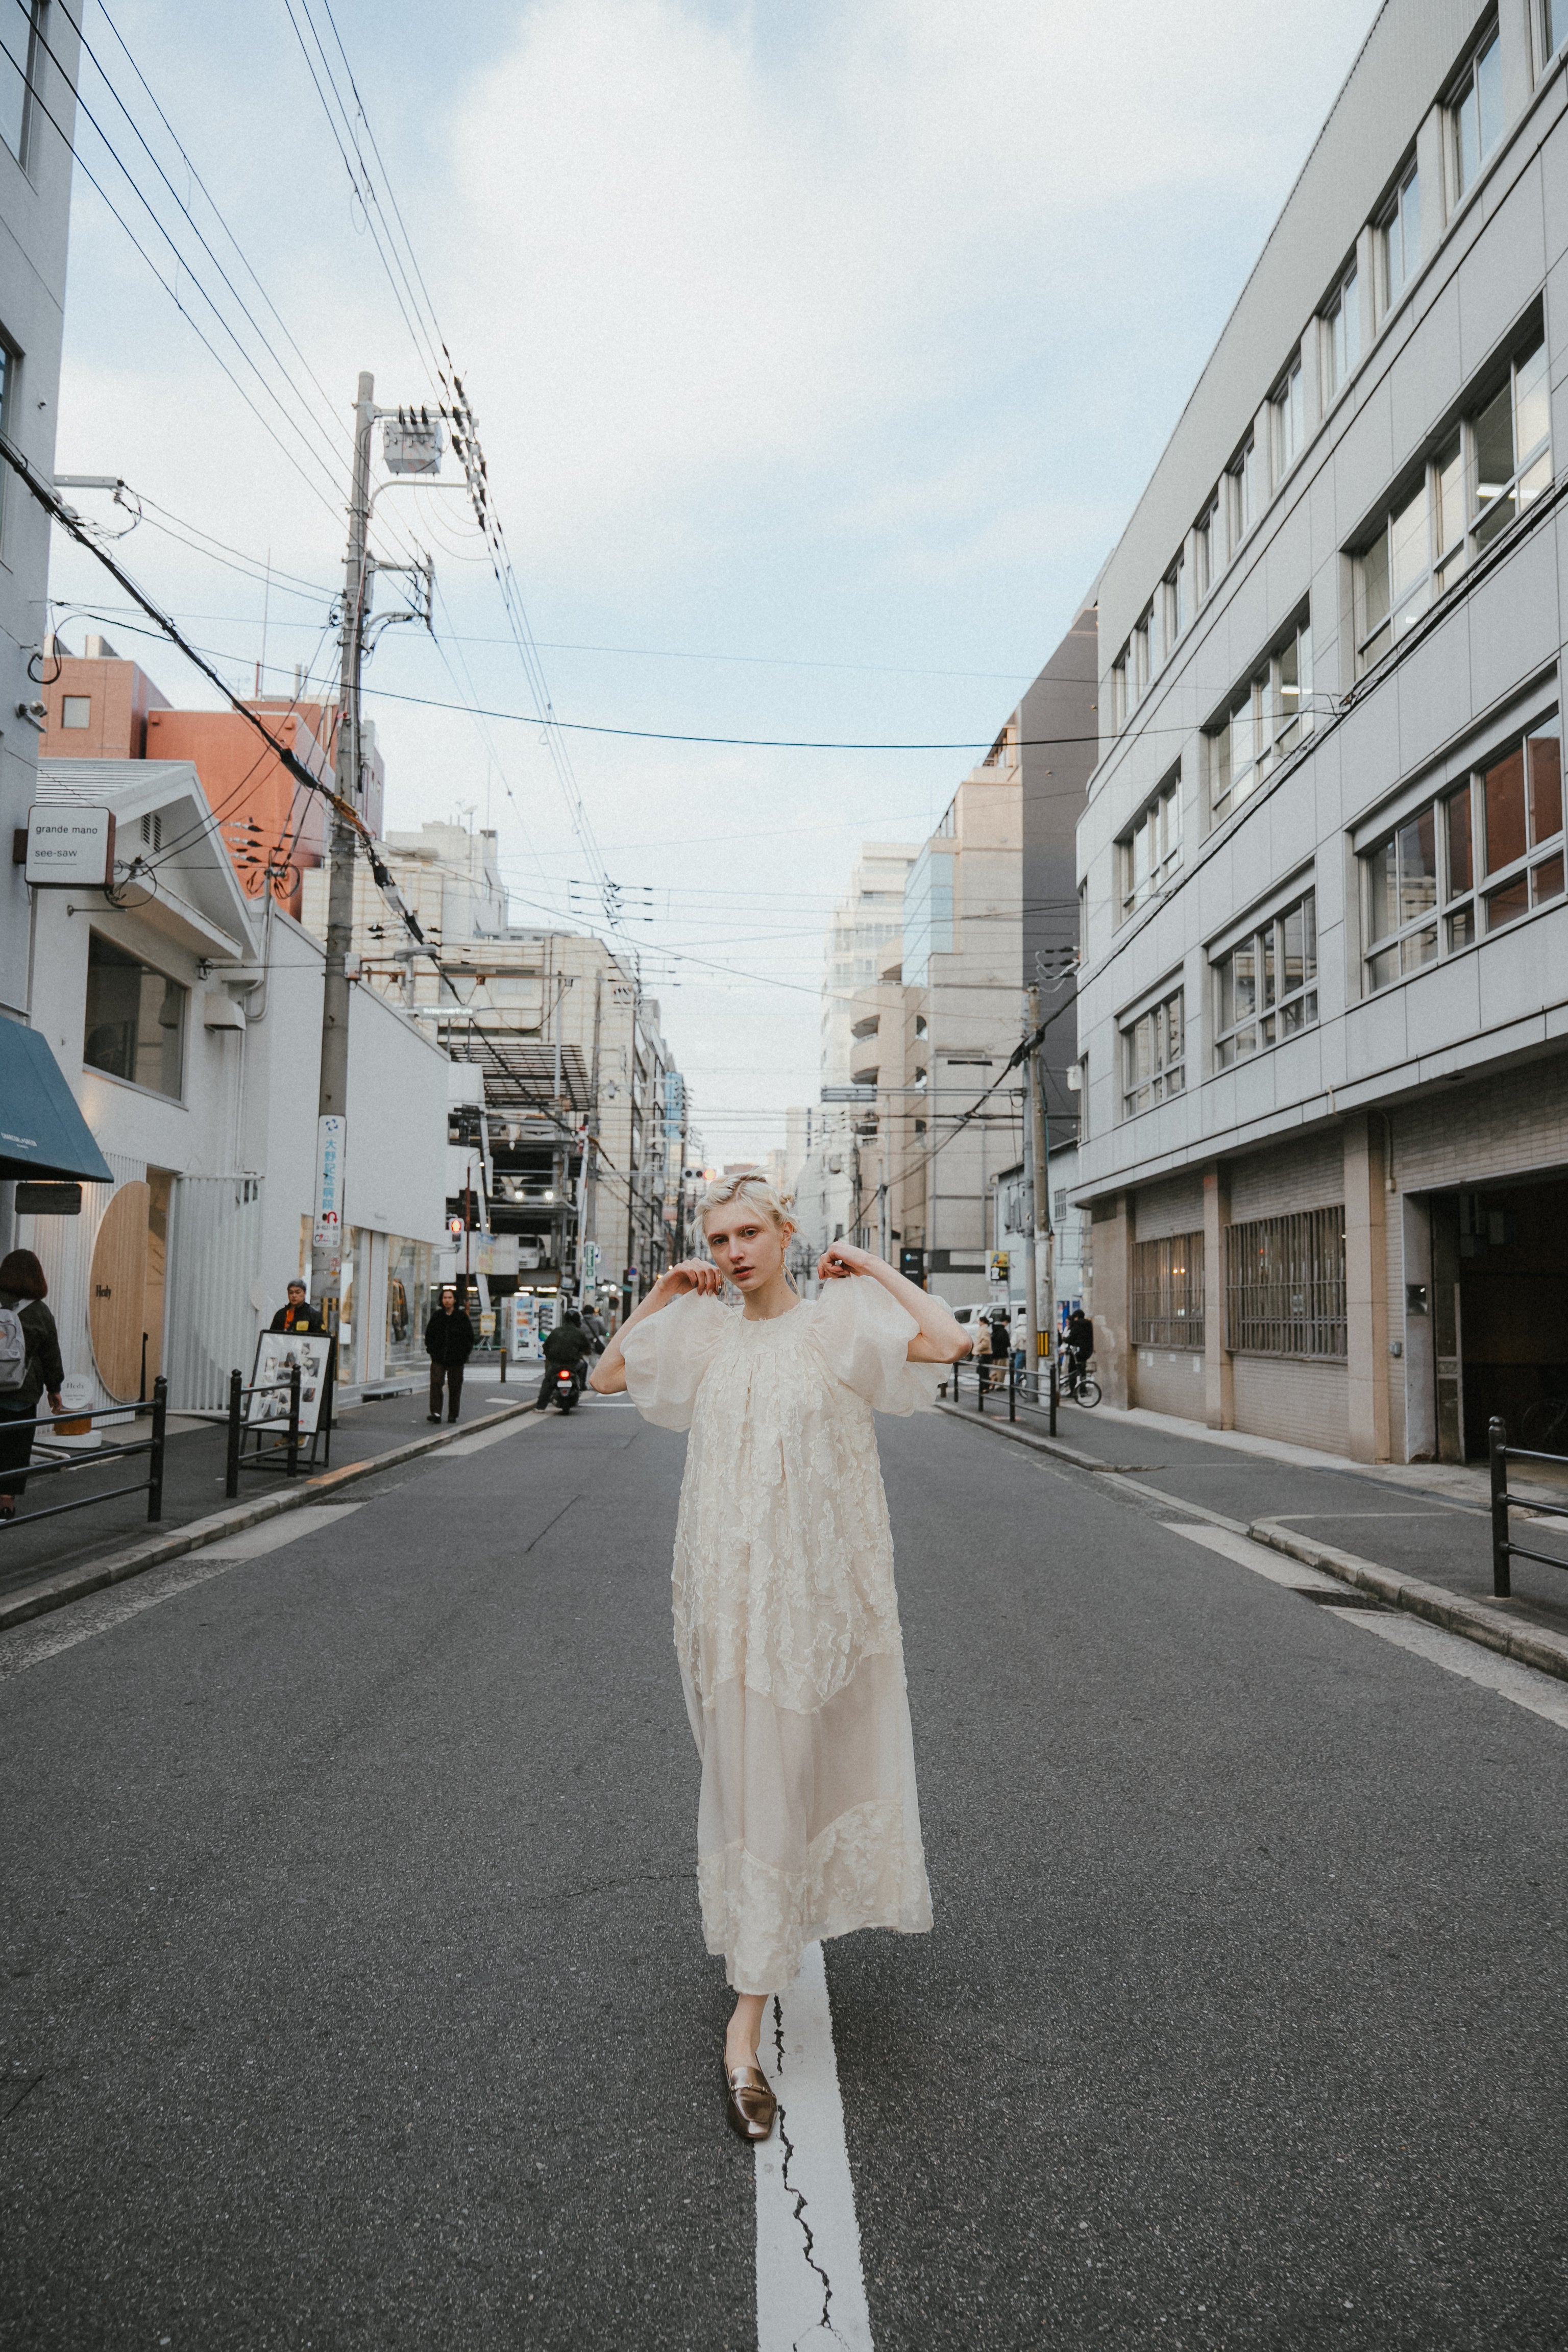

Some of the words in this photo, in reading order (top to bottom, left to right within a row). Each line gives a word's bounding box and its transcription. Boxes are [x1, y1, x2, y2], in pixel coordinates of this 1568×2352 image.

[36, 825, 68, 835] grande
[322, 1138, 336, 1210] 大野記念病院
